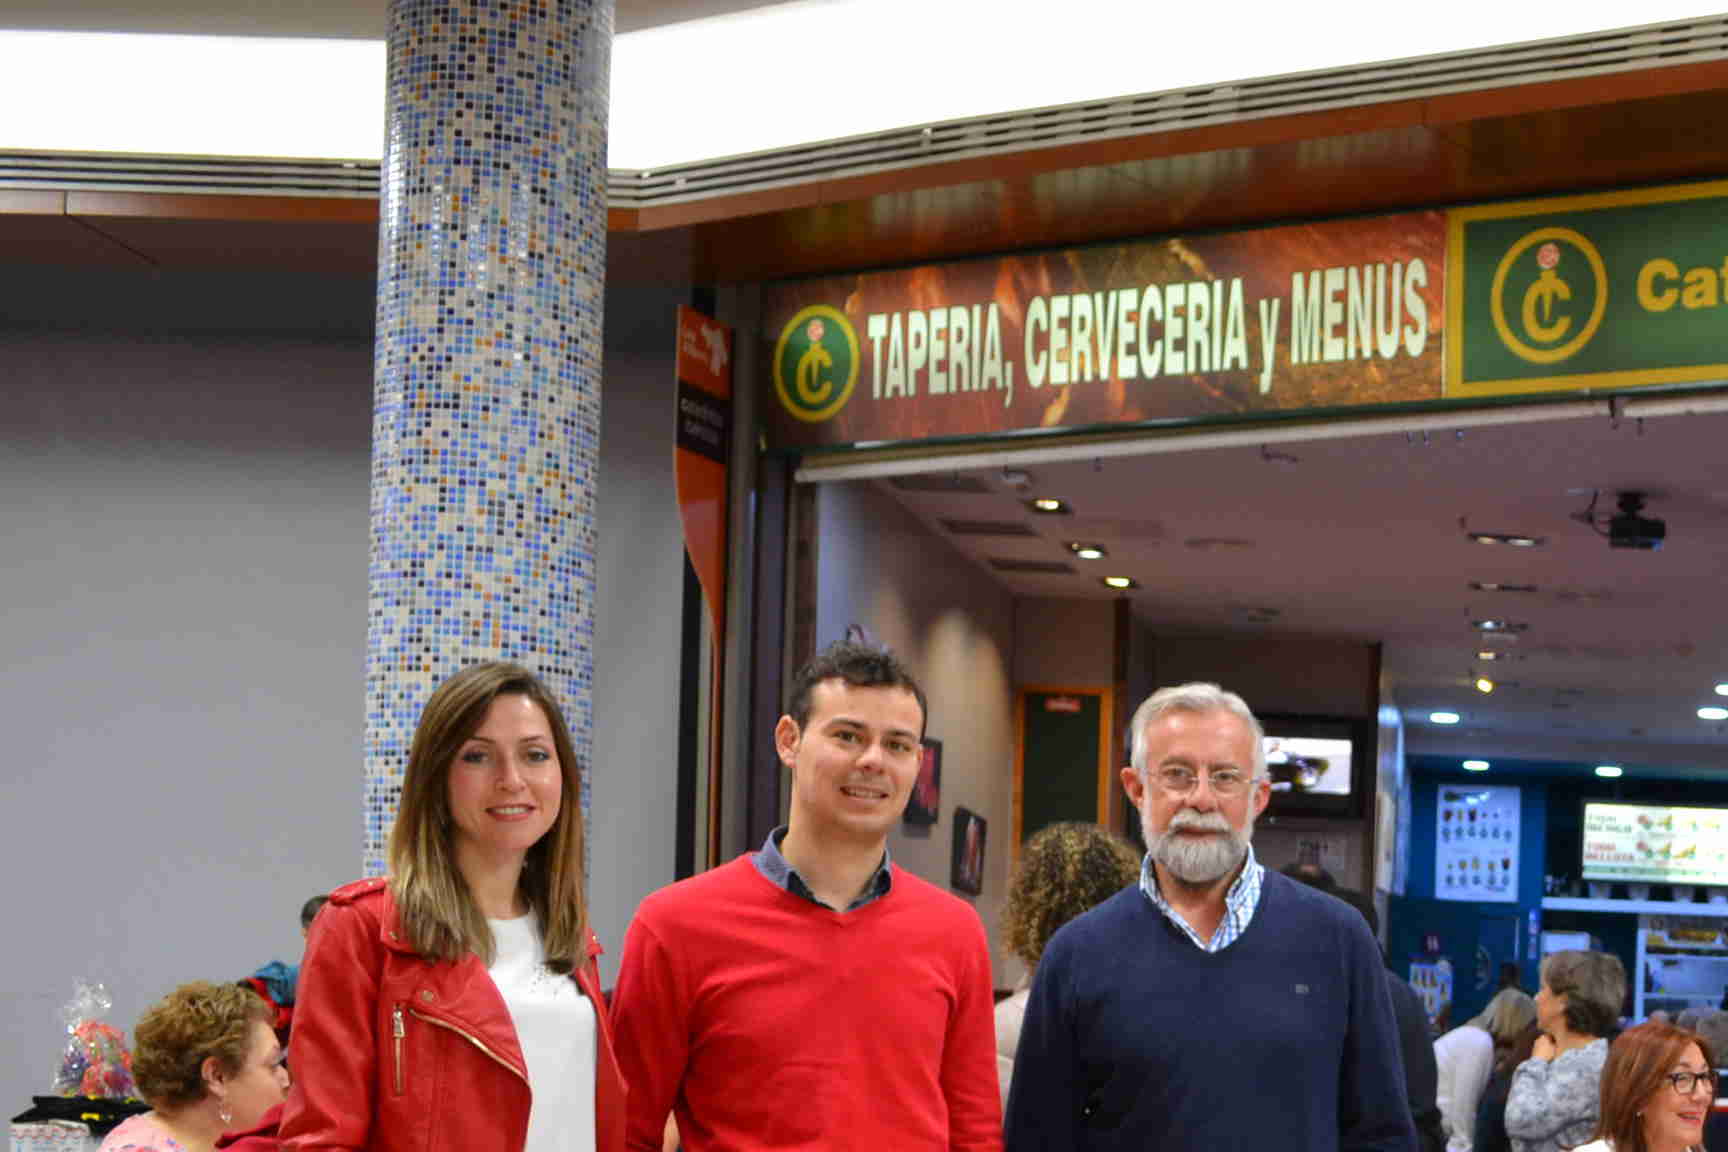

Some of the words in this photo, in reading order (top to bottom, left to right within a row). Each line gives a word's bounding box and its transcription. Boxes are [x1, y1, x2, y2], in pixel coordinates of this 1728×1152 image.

[867, 303, 1014, 408] TAPERIA,
[1024, 277, 1249, 388] CERVECERIA
[1258, 297, 1281, 395] y
[1290, 257, 1429, 365] MENUS
